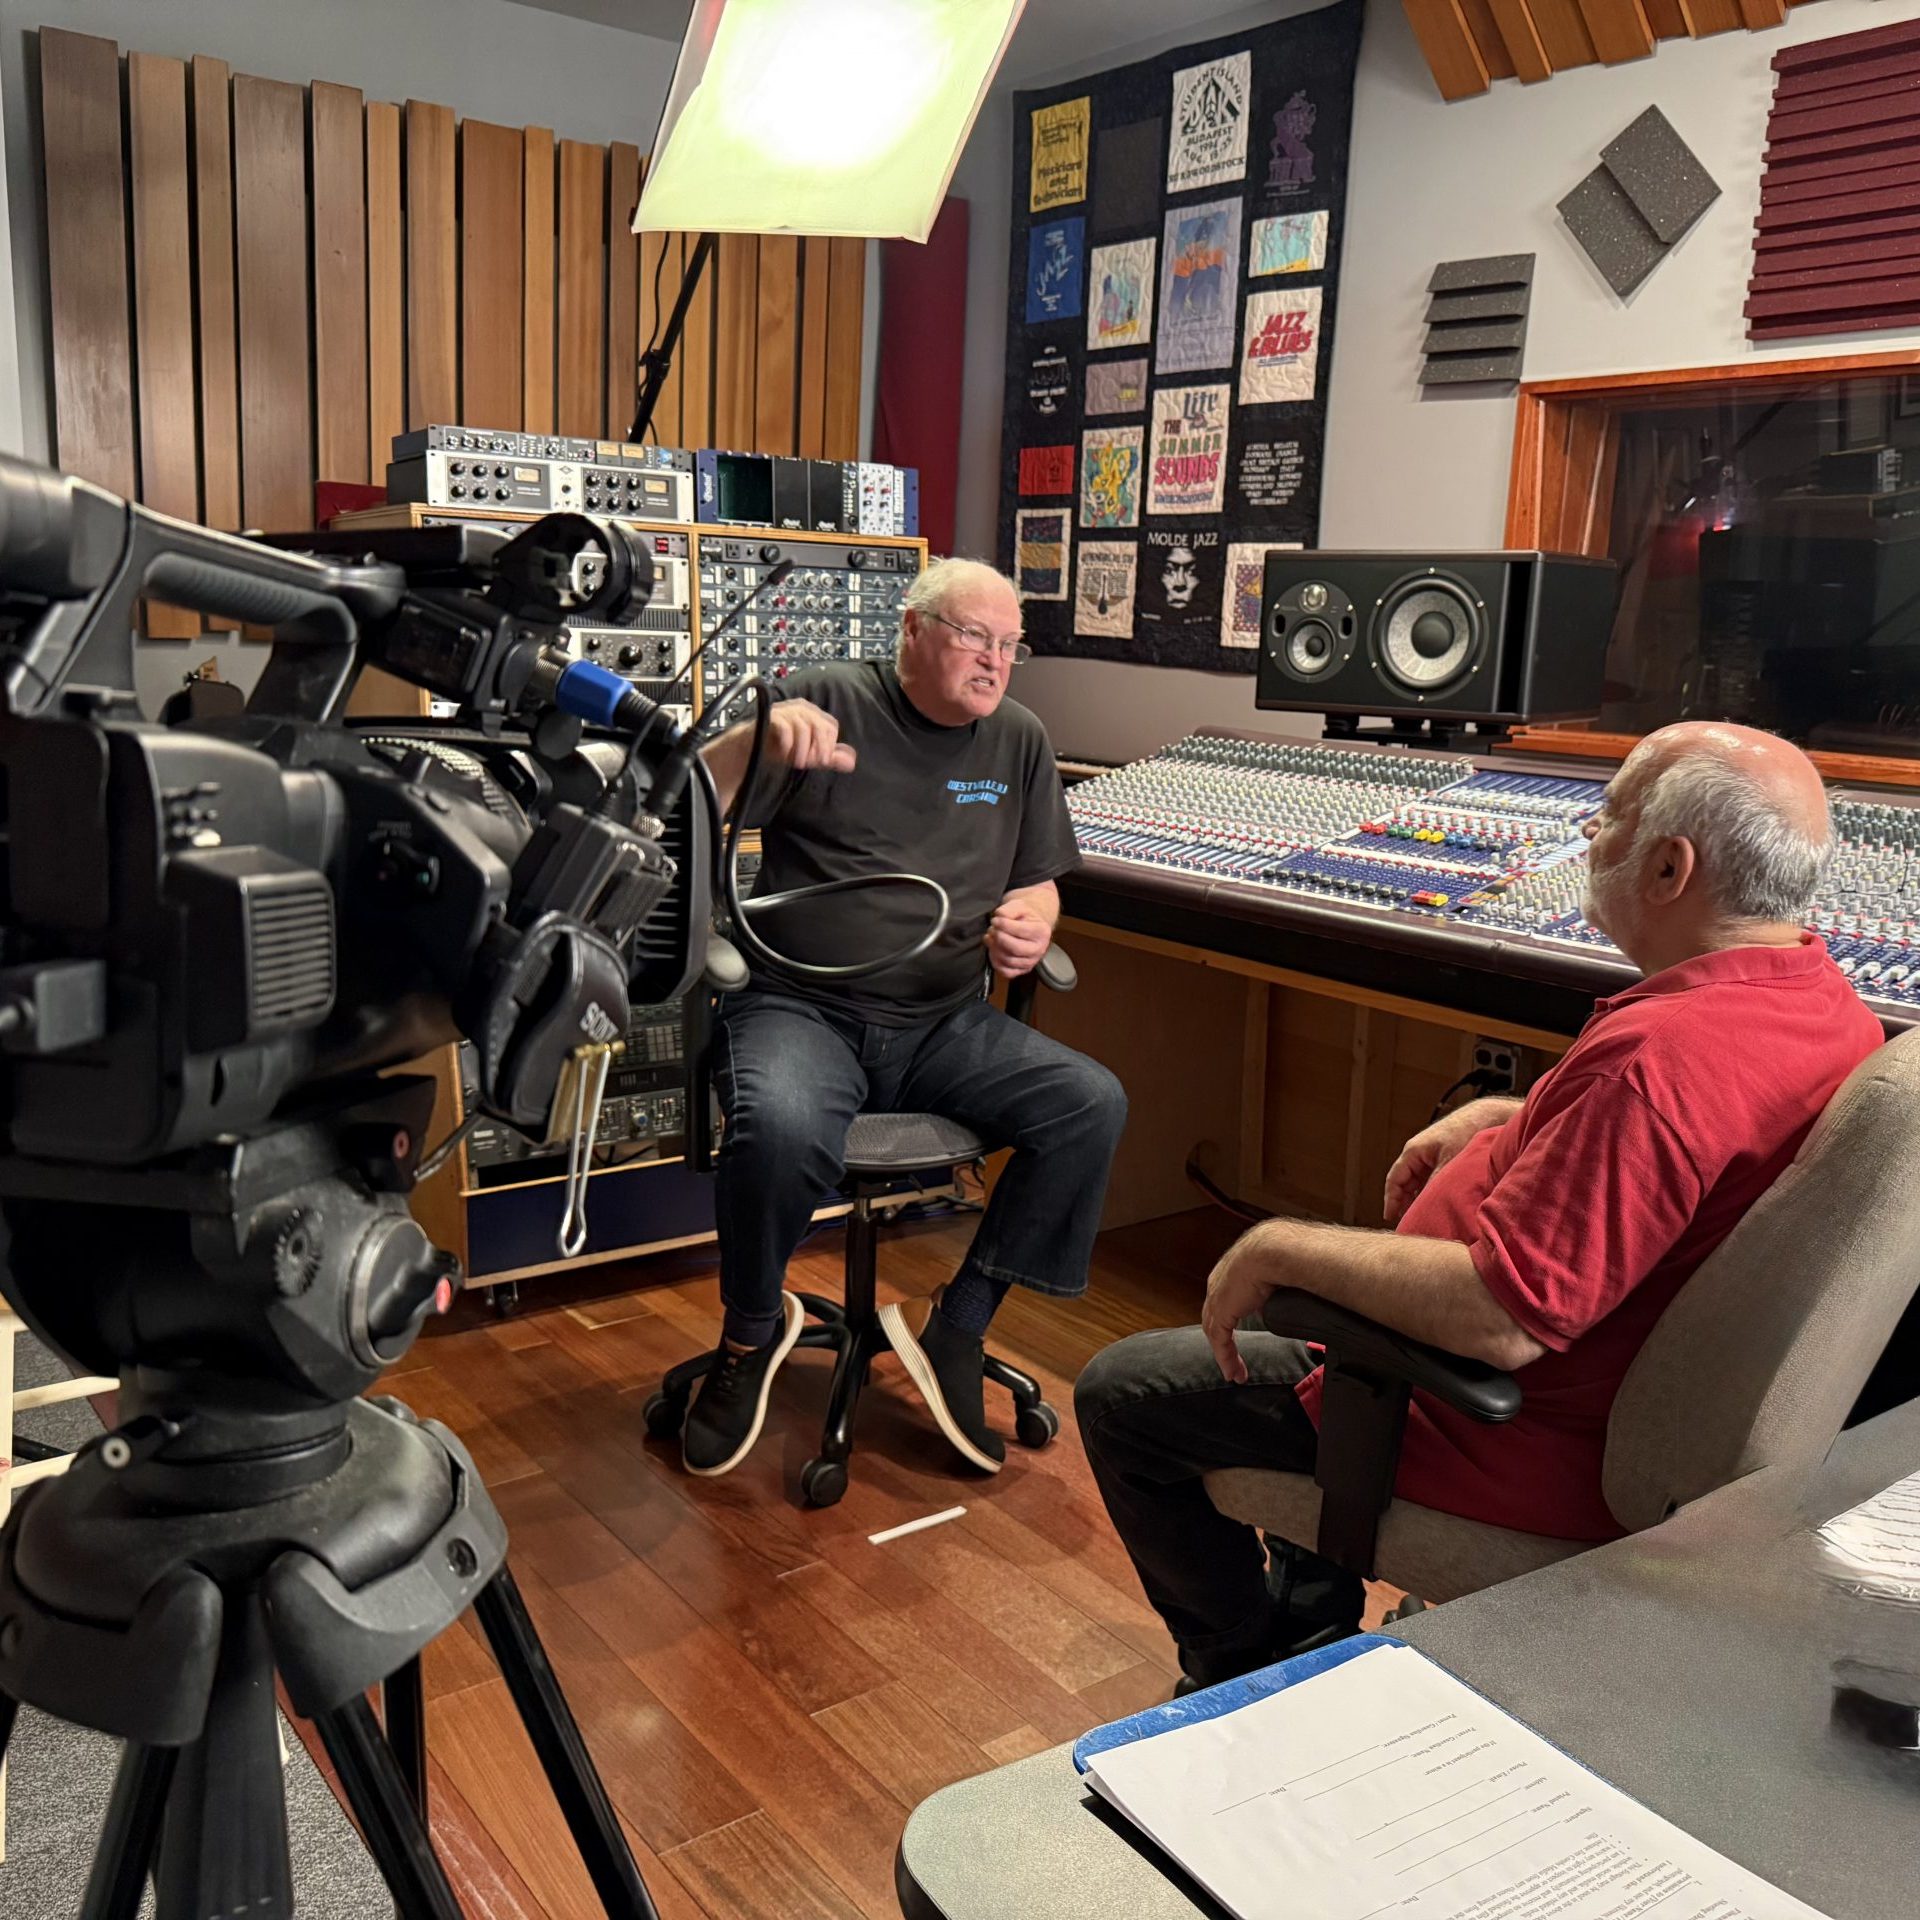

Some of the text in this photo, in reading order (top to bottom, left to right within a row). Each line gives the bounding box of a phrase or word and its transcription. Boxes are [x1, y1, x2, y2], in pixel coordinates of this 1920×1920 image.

[1187, 126, 1233, 146] BUDAPEST
[1049, 174, 1073, 188] and
[1260, 311, 1308, 337] JAZZ
[1184, 391, 1218, 420] Lite
[1164, 419, 1182, 434] THE
[1159, 433, 1221, 455] SUMMER
[1154, 452, 1221, 485] SOUNDS
[1147, 531, 1219, 549] MOLDE JAZZ
[1437, 1713, 1456, 1723] Parent
[1409, 1723, 1435, 1735] Guardian
[1457, 1727, 1476, 1737] Parent
[1429, 1736, 1455, 1749] Guardian
[1509, 1761, 1527, 1771] Phone
[1548, 1791, 1570, 1804] Printed
[1563, 1807, 1592, 1823] Signature:
[1572, 1859, 1586, 1869] right
[1627, 1862, 1642, 1870] This
[1525, 1873, 1540, 1882] from
[1595, 1868, 1611, 1879] social
[1609, 1869, 1630, 1881] footage
[1636, 1862, 1666, 1882] understand
[1514, 1880, 1526, 1888] any
[1596, 1879, 1610, 1888] may
[1662, 1873, 1692, 1893] permission
[1540, 1889, 1552, 1898] and
[1556, 1891, 1568, 1899] any
[1567, 1886, 1578, 1895] and
[1577, 1890, 1591, 1900] used
[1642, 1886, 1654, 1895] and
[1464, 1904, 1479, 1913] from
[1538, 1898, 1558, 1910] related
[1561, 1900, 1572, 1908] the
[1453, 1911, 1465, 1920] the
[1545, 1906, 1562, 1916] above
[1623, 1905, 1643, 1917] Name
